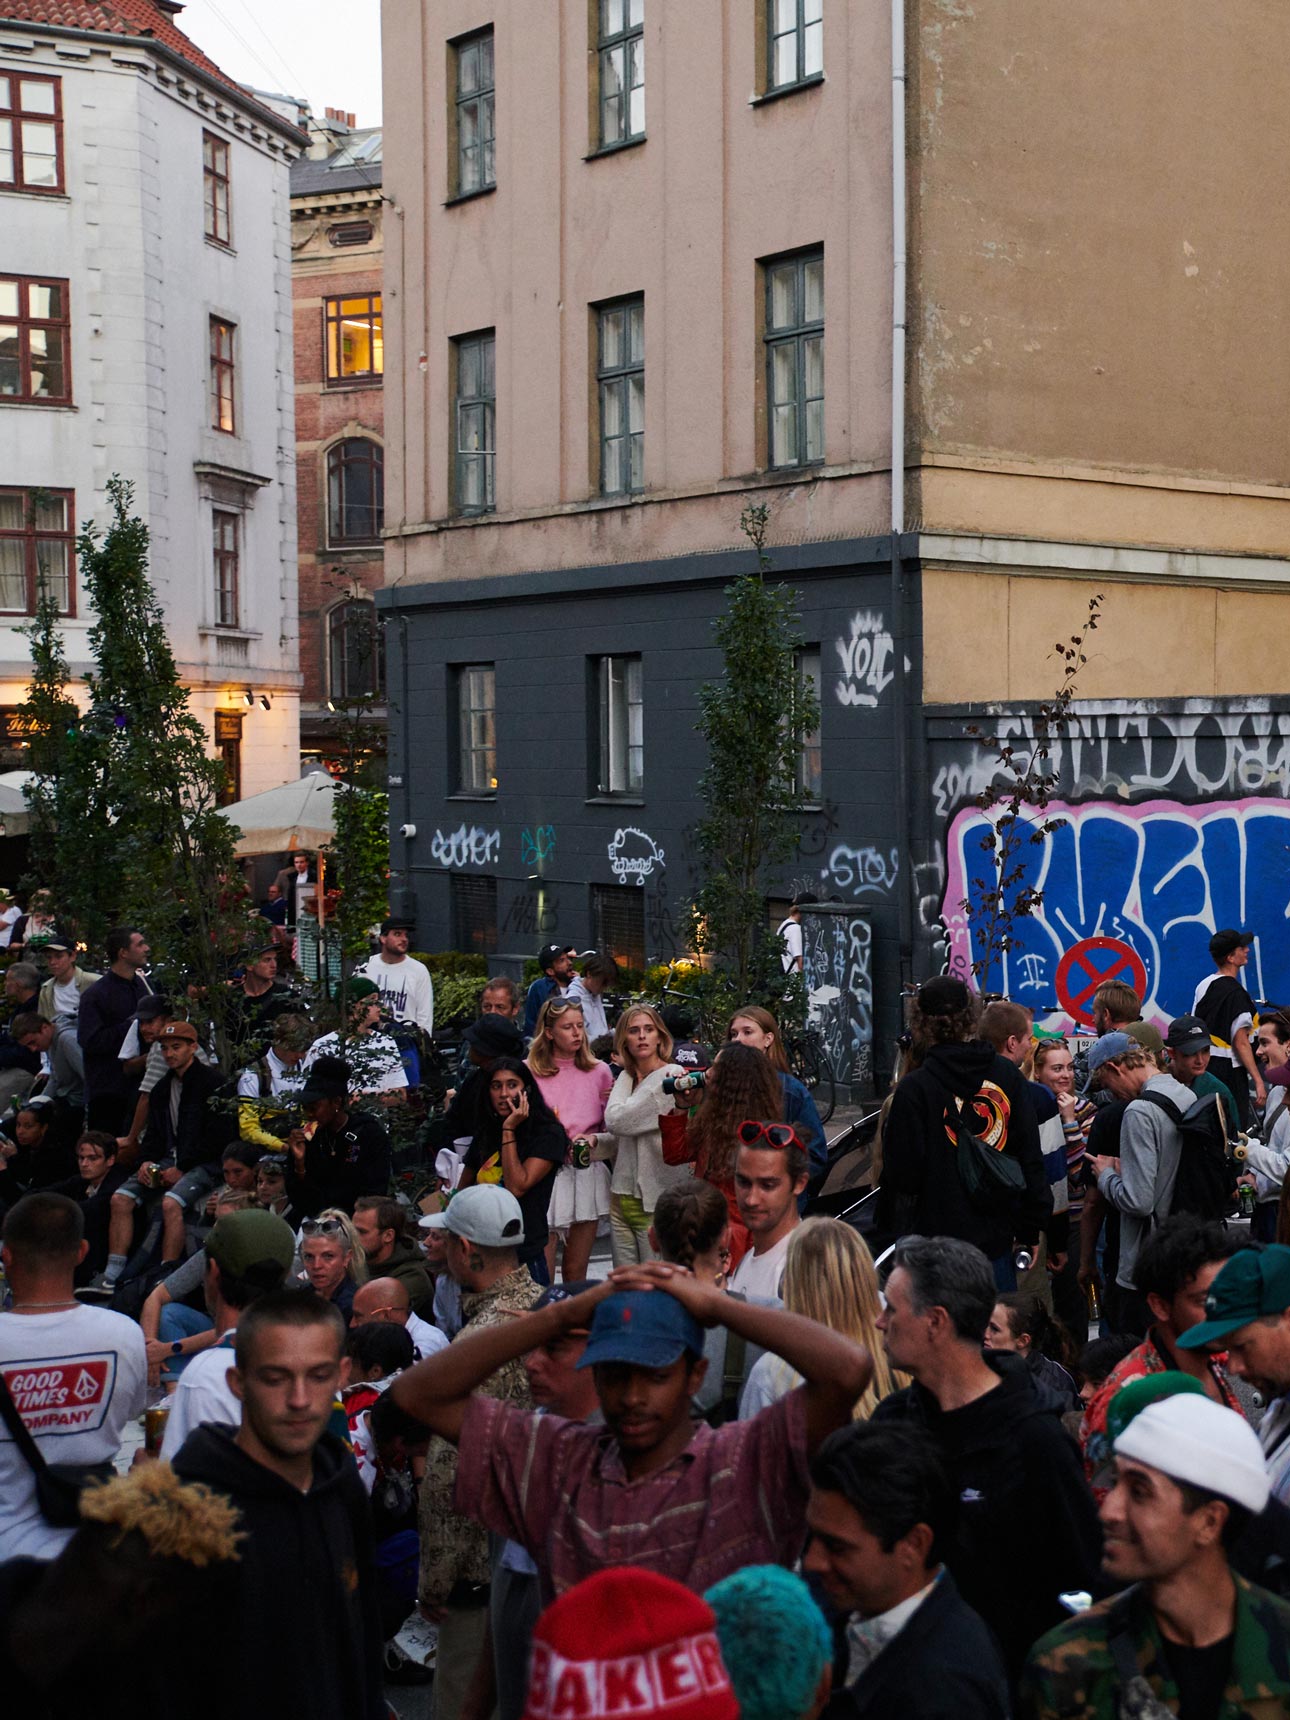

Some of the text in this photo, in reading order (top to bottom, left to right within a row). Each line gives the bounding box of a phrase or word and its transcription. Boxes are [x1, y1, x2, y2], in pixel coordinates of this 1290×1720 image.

[10, 1370, 63, 1392] GOOD
[15, 1387, 69, 1409] TIMES
[22, 1408, 94, 1429] OMPANY
